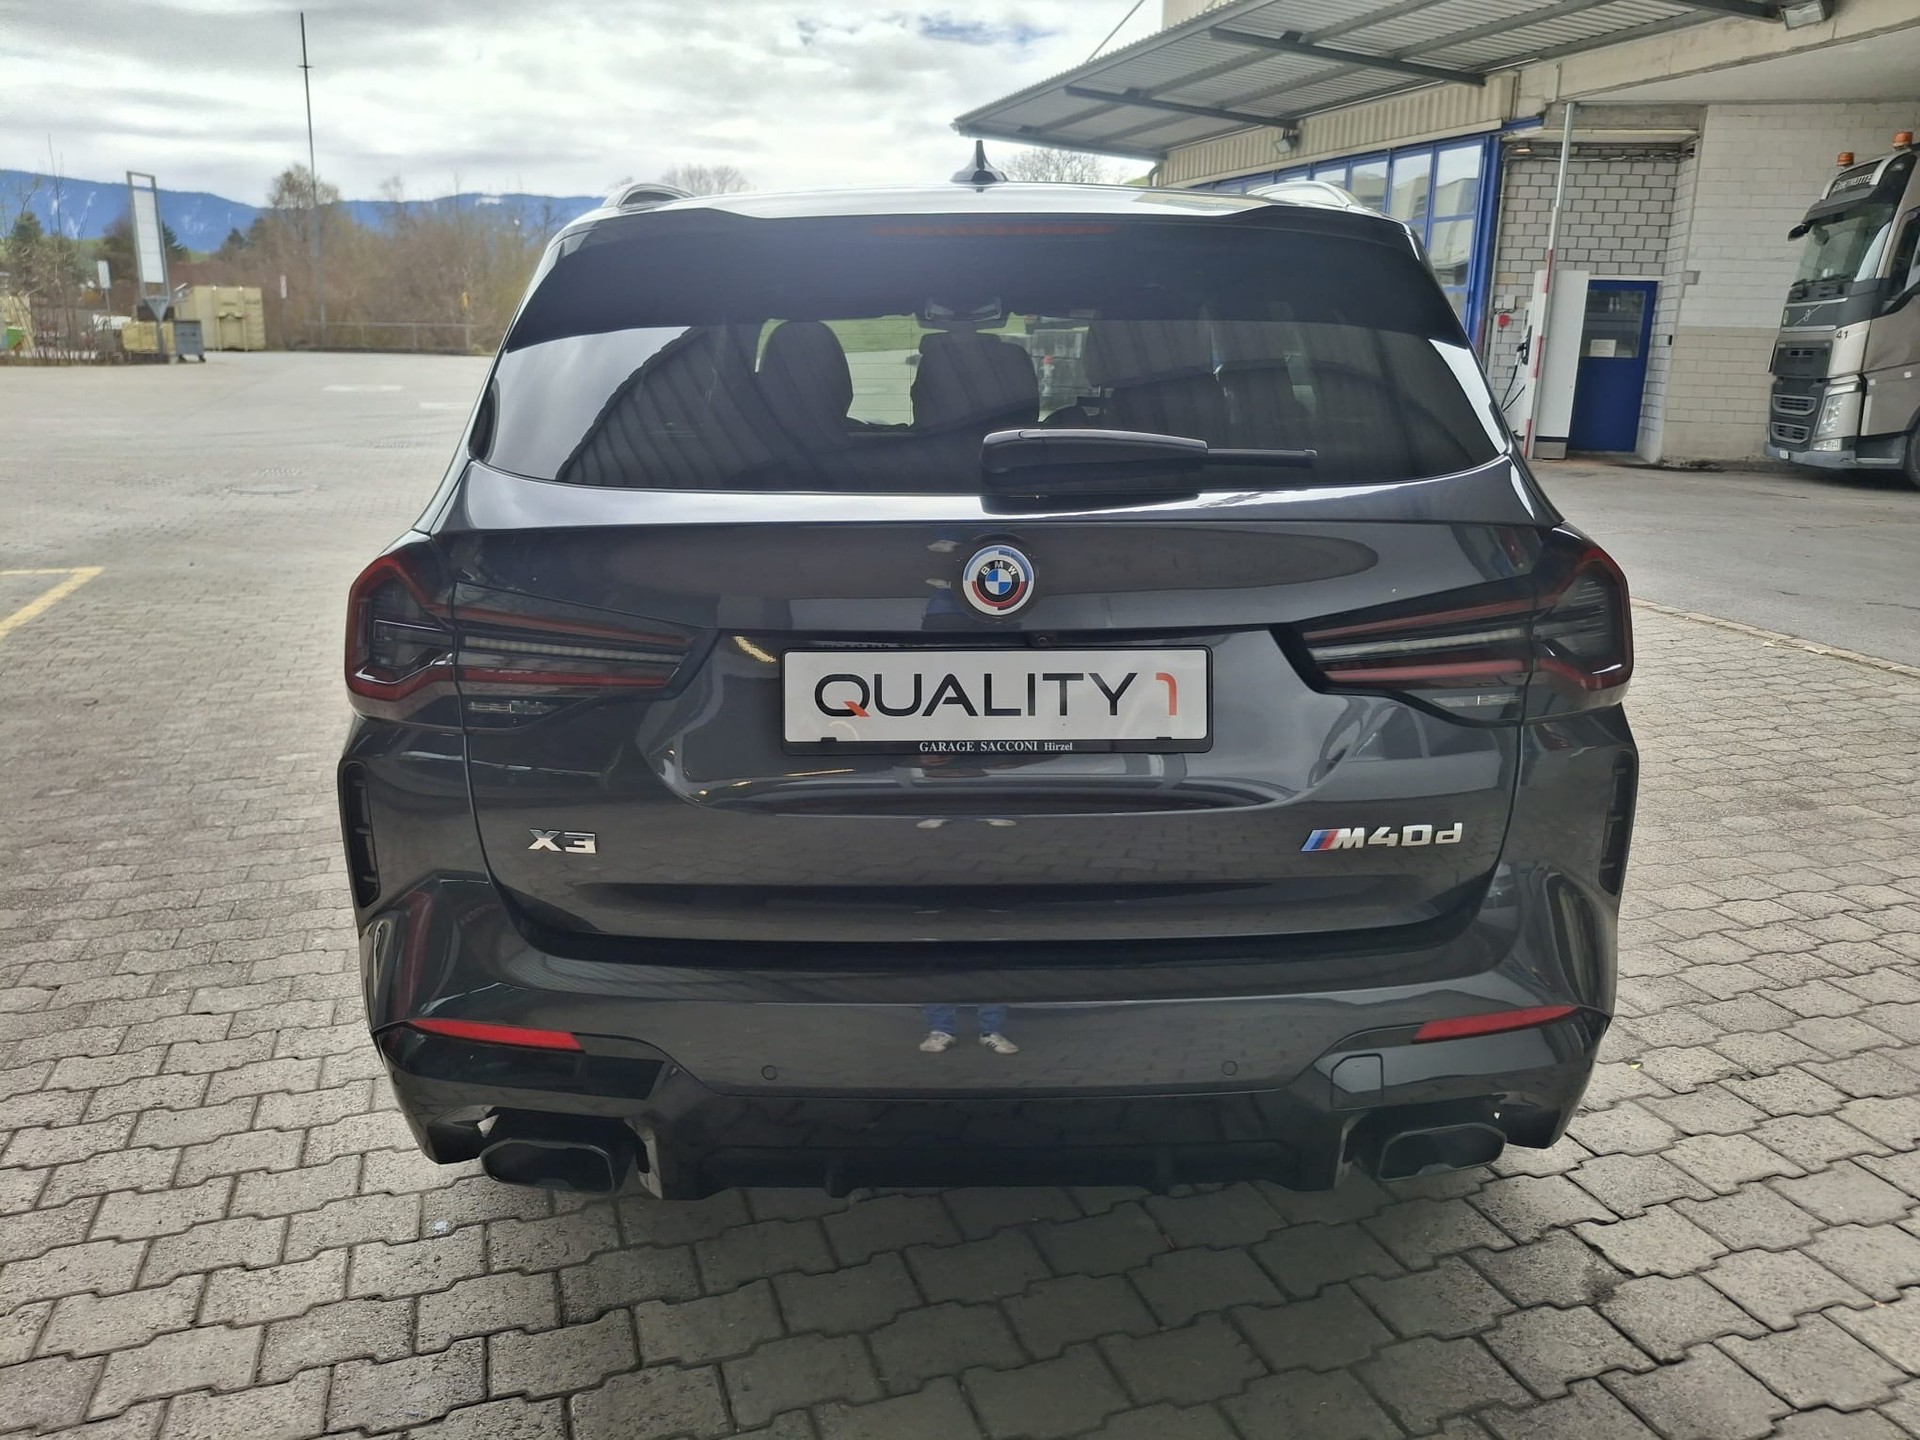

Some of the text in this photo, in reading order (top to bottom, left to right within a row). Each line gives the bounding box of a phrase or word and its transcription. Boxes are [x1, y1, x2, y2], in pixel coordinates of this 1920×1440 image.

[981, 560, 1017, 576] BMW
[814, 673, 1138, 717] QUALITY
[919, 740, 1073, 752] GARAGE SACCONI Hirzel
[528, 829, 597, 854] X3
[1327, 822, 1463, 850] M40d
